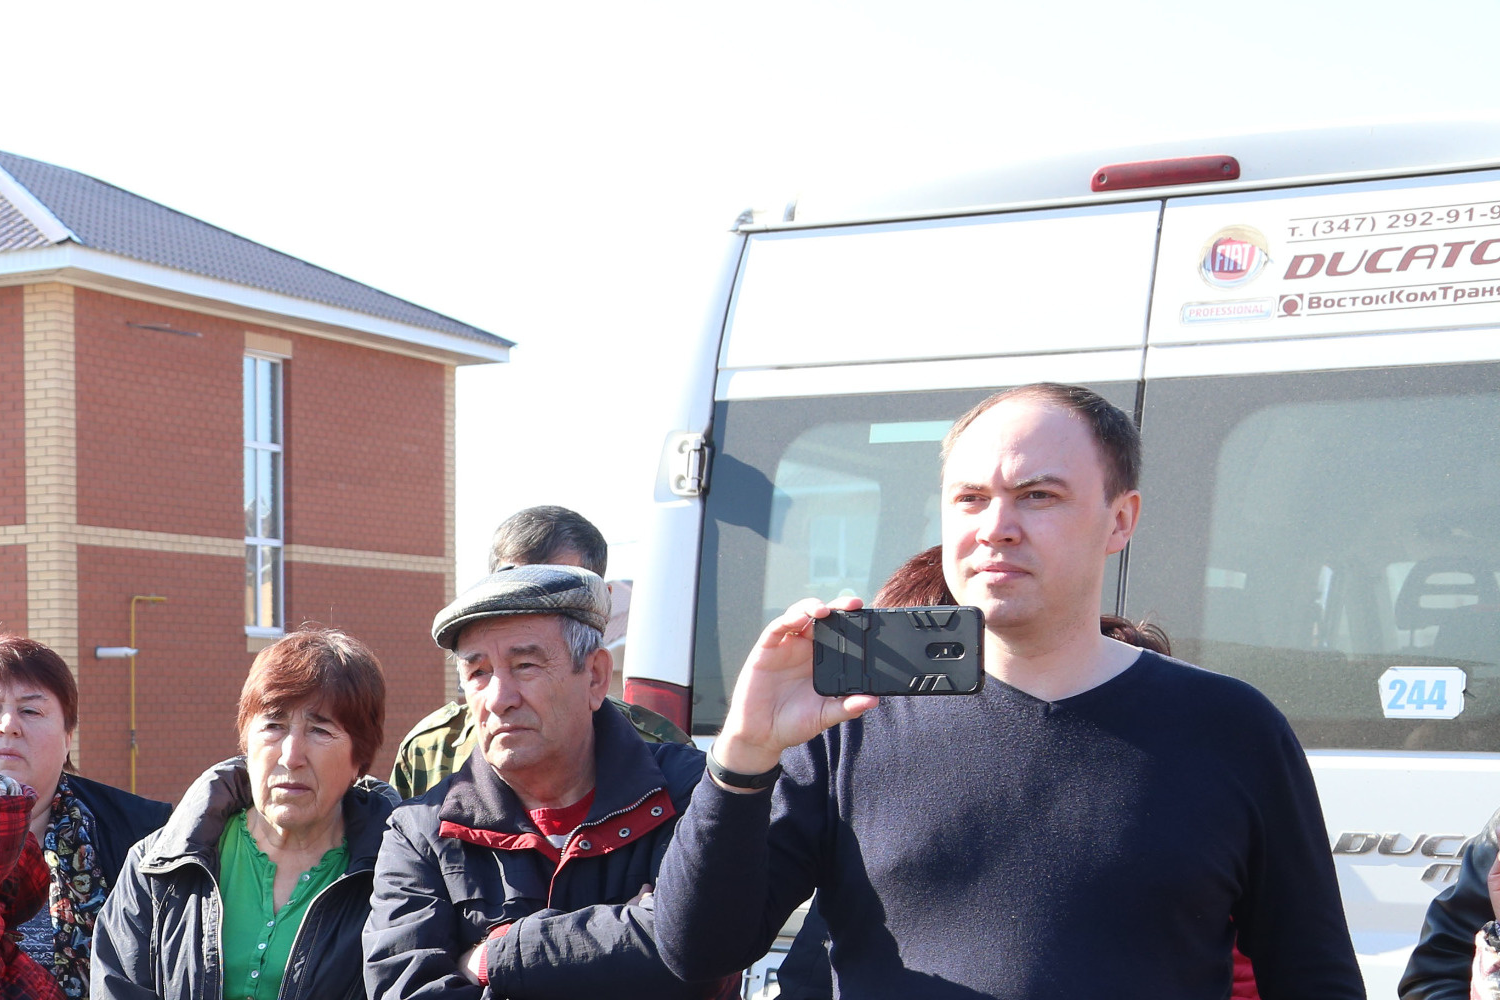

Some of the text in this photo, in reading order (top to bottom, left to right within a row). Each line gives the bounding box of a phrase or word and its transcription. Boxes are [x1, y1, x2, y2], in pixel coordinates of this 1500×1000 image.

[1311, 215, 1377, 237] (347)
[1214, 243, 1251, 272] FIAT
[1188, 303, 1265, 318] PROFESSIONAL
[1387, 679, 1448, 710] 244
